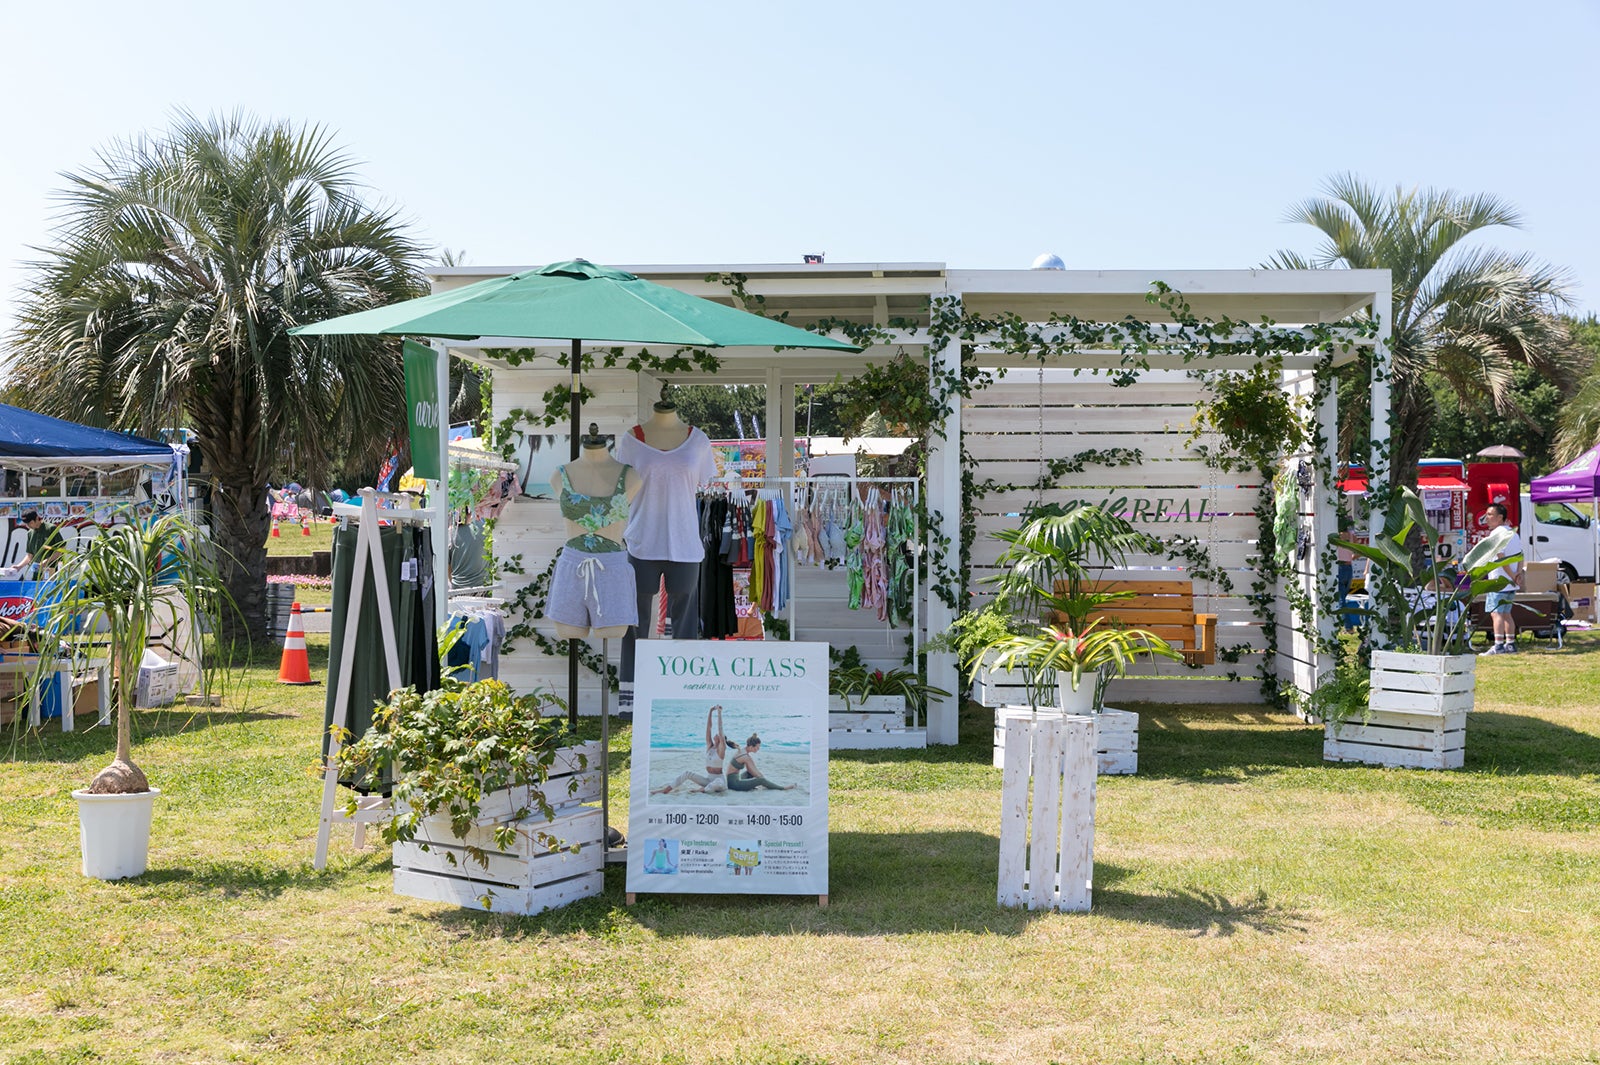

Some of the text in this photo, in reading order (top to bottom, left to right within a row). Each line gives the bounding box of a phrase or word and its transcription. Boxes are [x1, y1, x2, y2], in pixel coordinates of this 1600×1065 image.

[1453, 491, 1462, 521] BEACH
[657, 655, 806, 678] YOGA CLASS
[757, 684, 780, 692] EVENT
[666, 813, 687, 825] 11:00
[696, 813, 719, 825] 12:00
[747, 814, 770, 826] 14:00
[779, 814, 803, 826] 15:00
